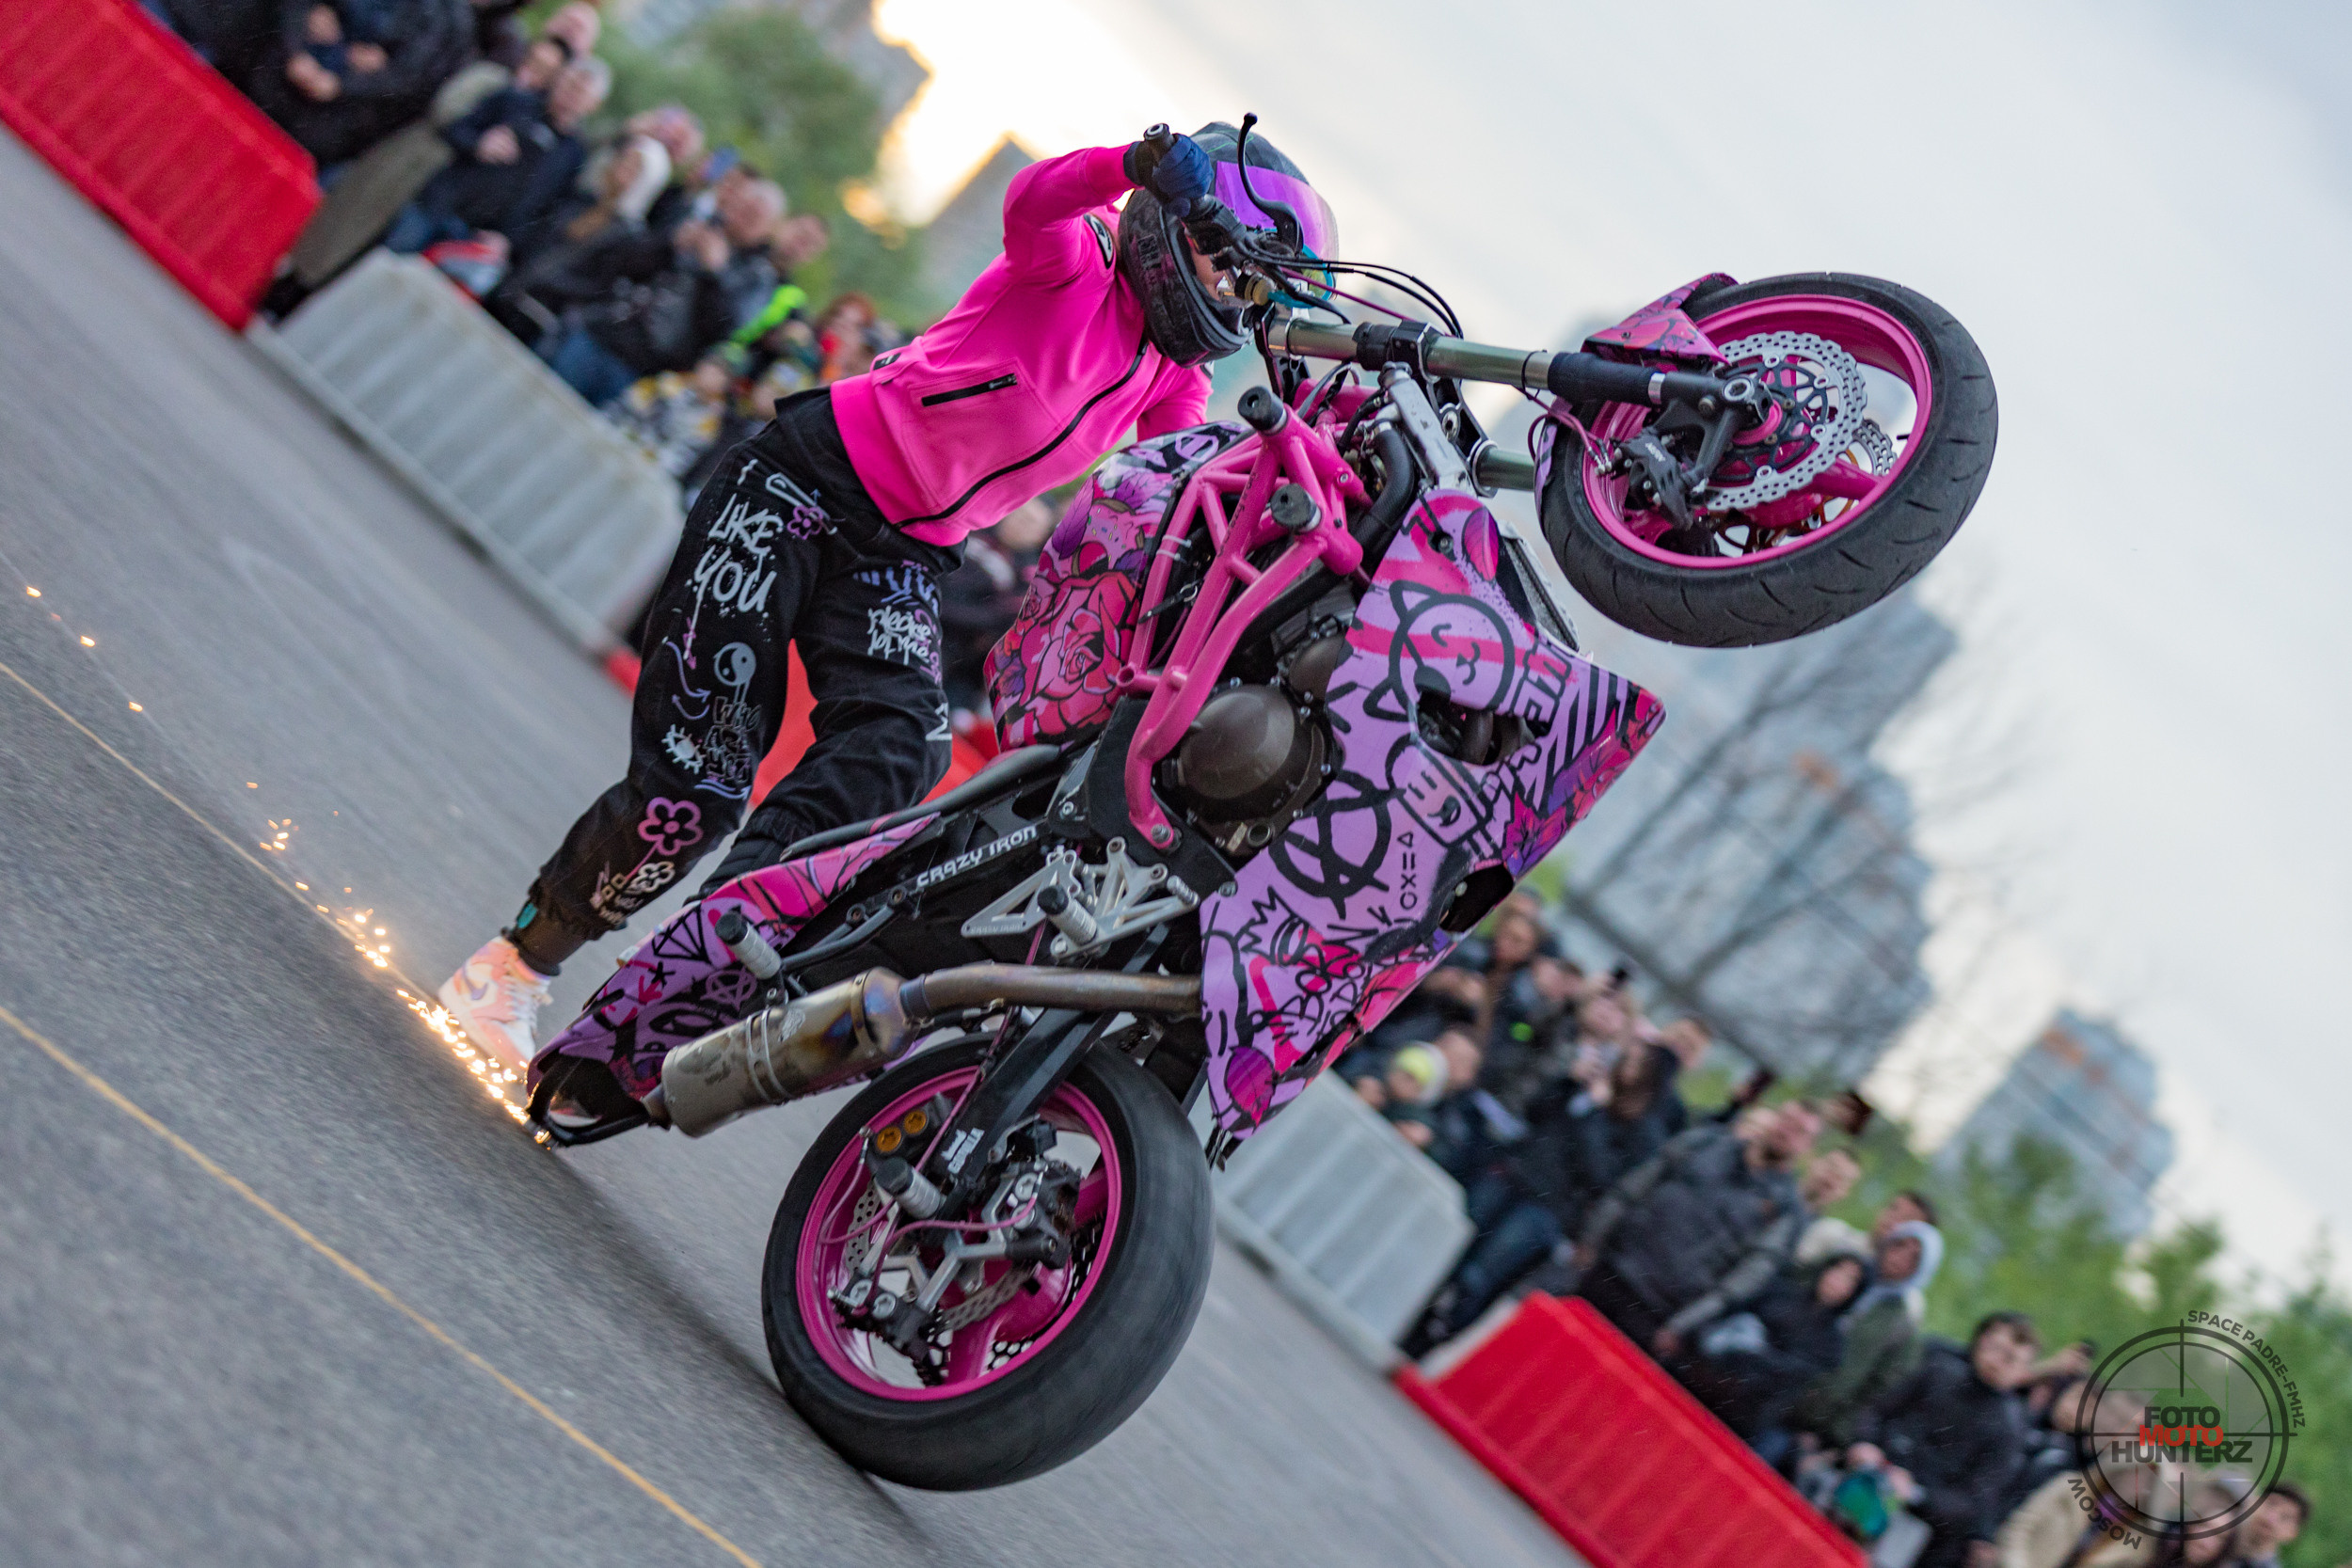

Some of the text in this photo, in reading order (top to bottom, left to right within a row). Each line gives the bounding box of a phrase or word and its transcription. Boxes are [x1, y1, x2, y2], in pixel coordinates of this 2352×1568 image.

[691, 544, 777, 623] YOU
[916, 825, 1038, 888] CRAZY IRON
